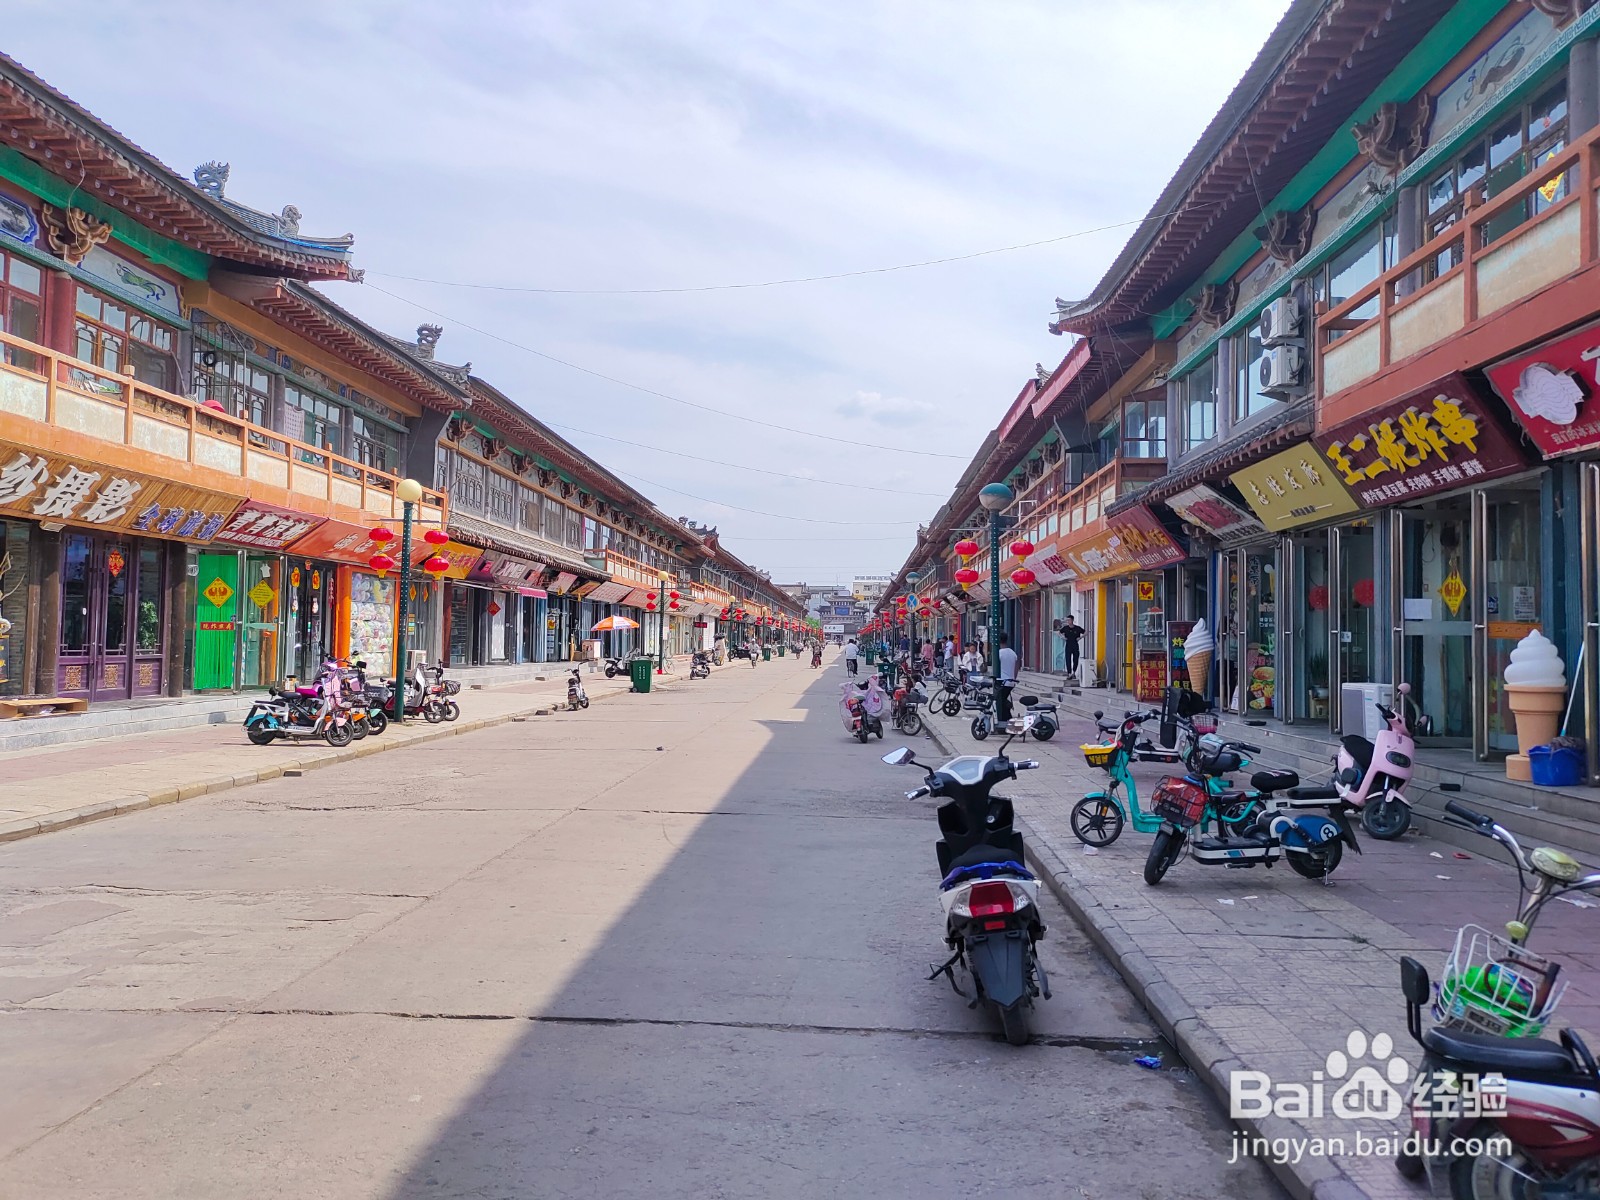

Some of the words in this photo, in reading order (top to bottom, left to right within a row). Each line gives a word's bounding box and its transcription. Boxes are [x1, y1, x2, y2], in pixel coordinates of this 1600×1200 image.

[1431, 465, 1463, 485] 手抓饼
[132, 502, 225, 541] 全球旅拍
[228, 509, 310, 538] 青青凉粉
